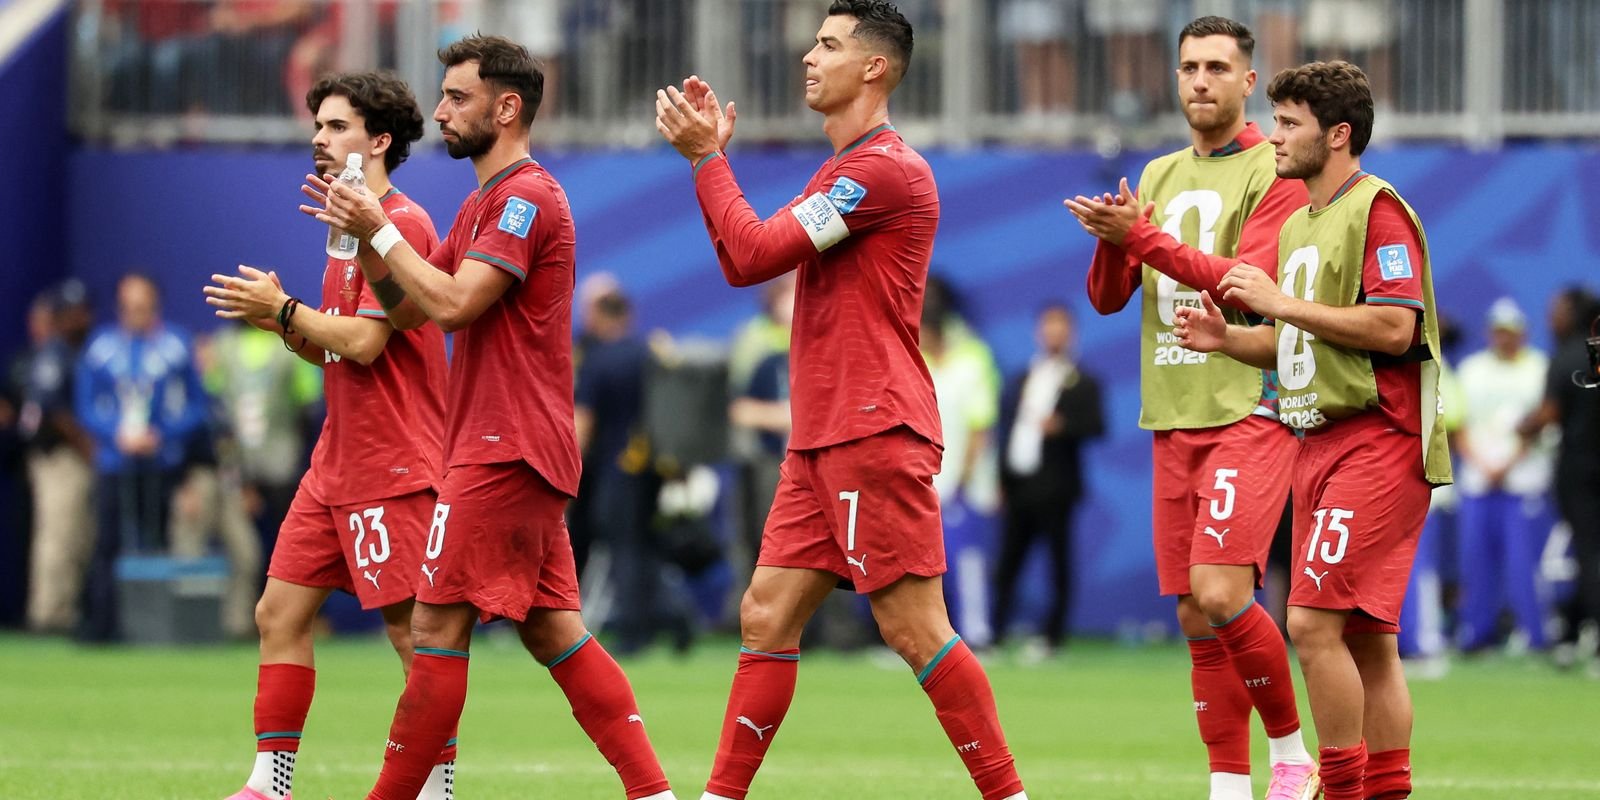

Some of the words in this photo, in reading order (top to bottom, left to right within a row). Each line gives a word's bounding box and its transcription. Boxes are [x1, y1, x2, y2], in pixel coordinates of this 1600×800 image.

[808, 199, 830, 225] UNITES
[1156, 332, 1178, 343] WOR
[838, 489, 860, 551] 7
[1209, 468, 1238, 521] 5
[348, 505, 391, 569] 23
[425, 502, 451, 560] 8
[1306, 508, 1354, 564] 15
